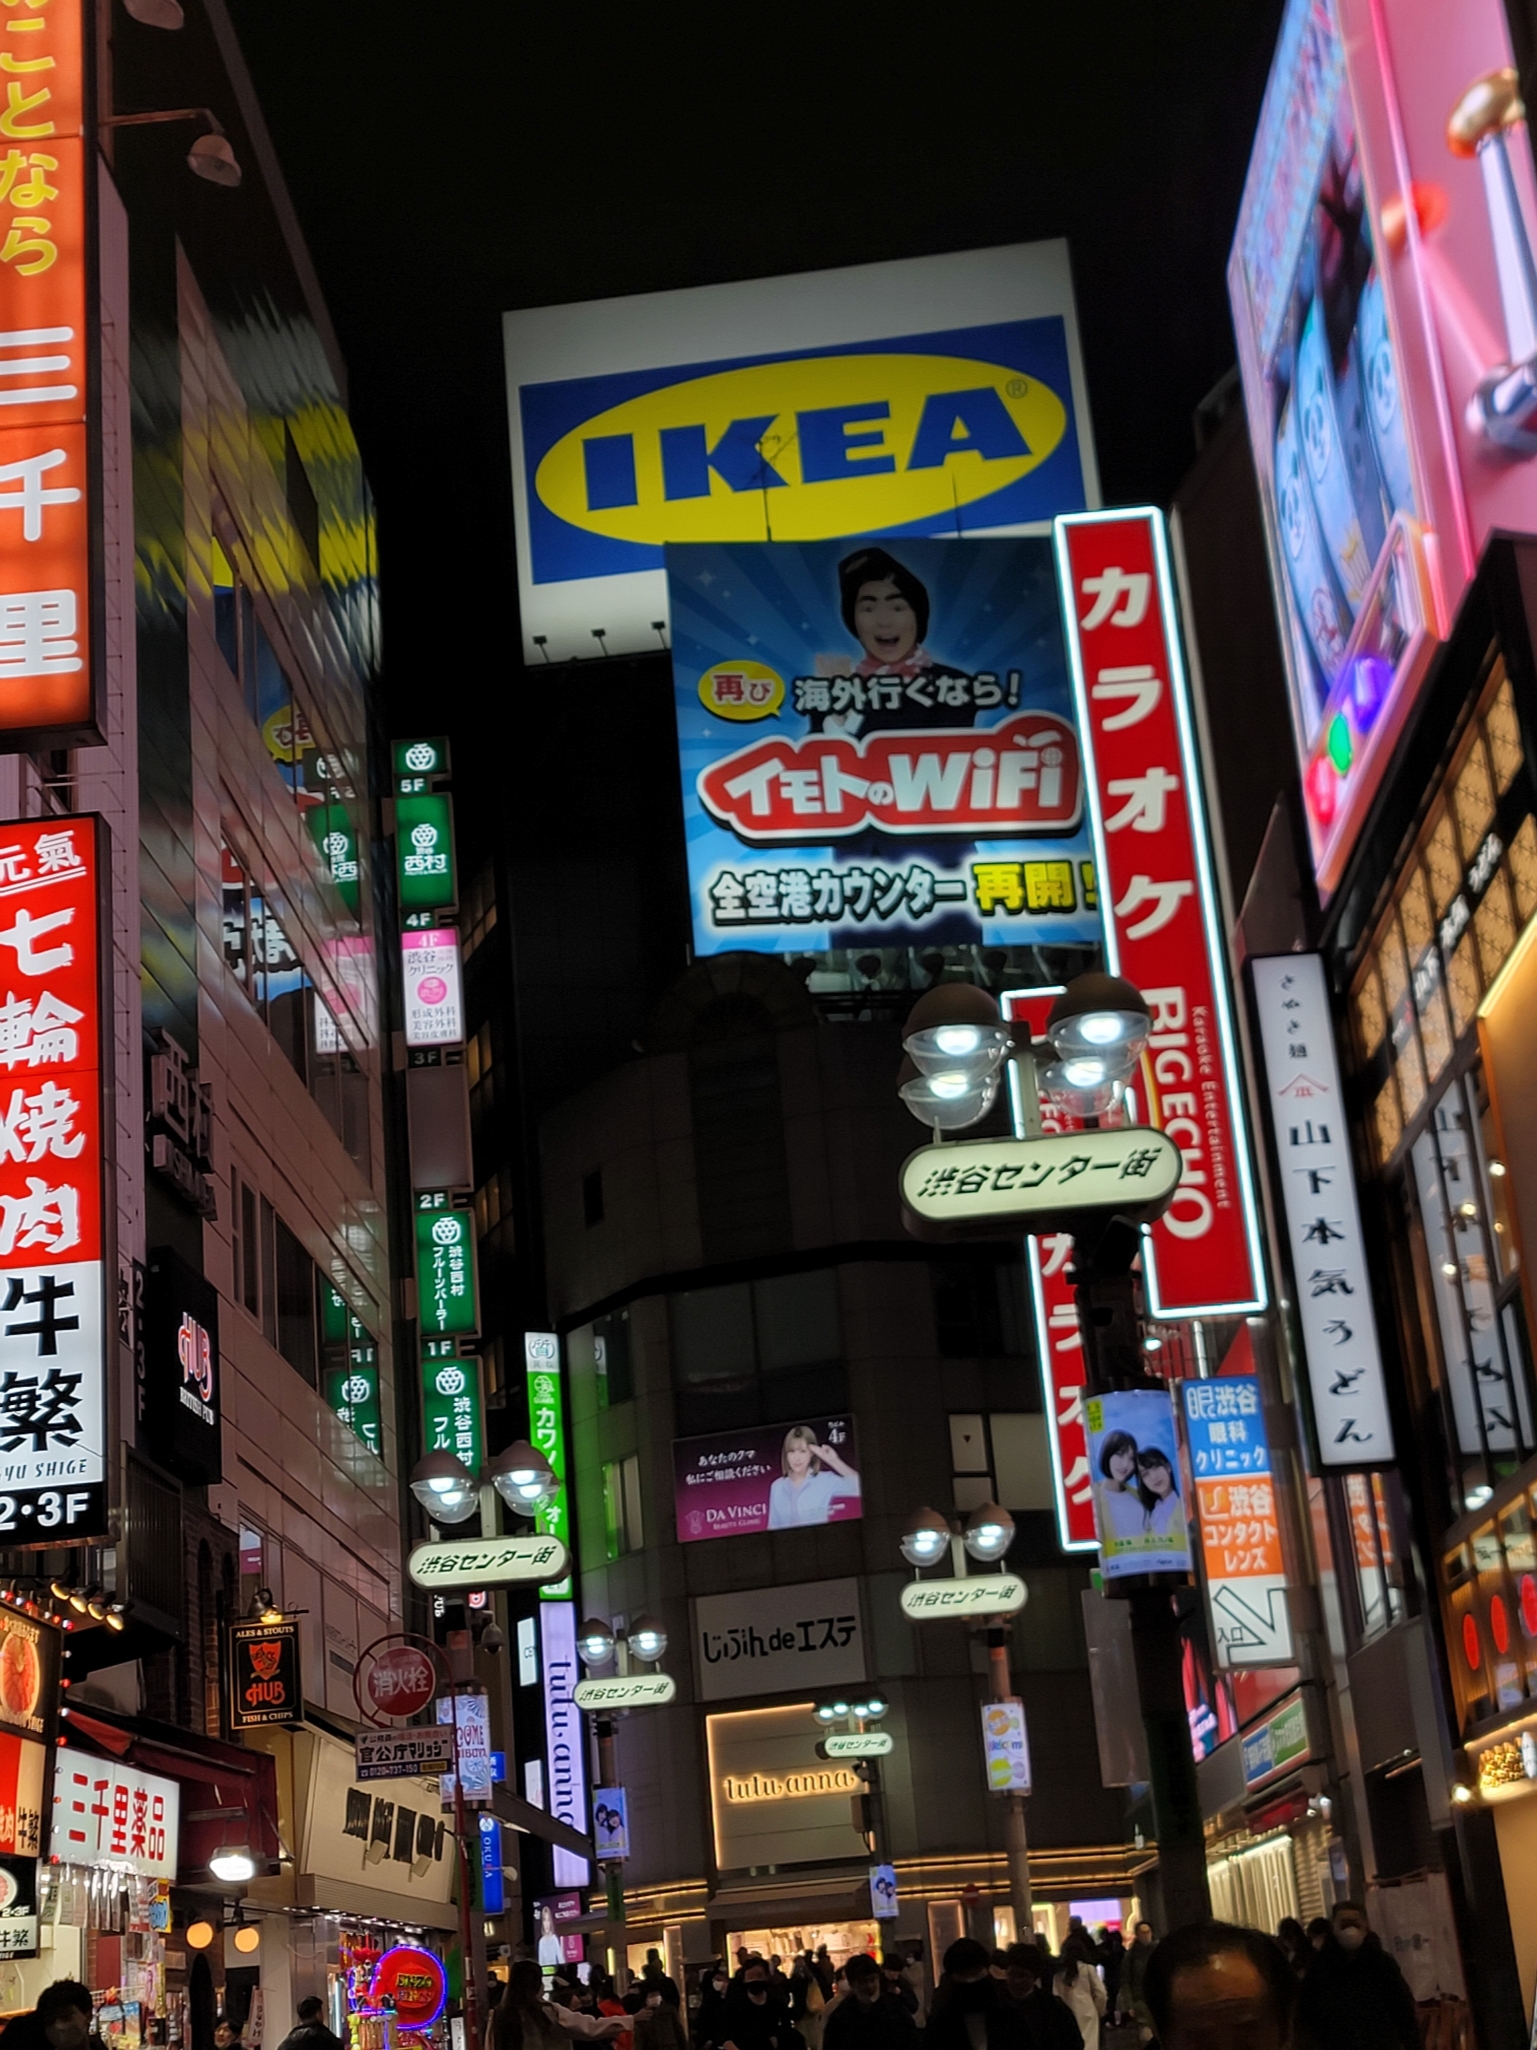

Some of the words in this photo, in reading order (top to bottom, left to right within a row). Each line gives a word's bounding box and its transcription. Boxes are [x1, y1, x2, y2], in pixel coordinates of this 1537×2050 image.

[0, 0, 59, 276] ことなら
[582, 385, 1034, 512] IKEA
[0, 326, 83, 678] 三千里
[713, 672, 772, 704] 再び
[794, 672, 1022, 714] 海外行くなら!
[1081, 566, 1194, 941] カラオケ
[401, 778, 424, 793] 5F
[723, 746, 1063, 816] イモトのWiFi
[404, 854, 447, 872] 西村
[406, 912, 432, 928] 4F
[418, 932, 440, 948] 4F
[407, 950, 437, 965] 渋谷
[408, 963, 454, 977] クリニック
[1191, 1005, 1215, 1075] Karaoke
[414, 1052, 437, 1065] 3F
[1201, 1081, 1232, 1210] Entertainment
[917, 1147, 1163, 1197] 渋谷センター街
[1160, 1092, 1214, 1240] ECHO
[419, 1193, 445, 1208] 2F
[448, 1245, 464, 1296] 渋谷西村
[1288, 1118, 1374, 1445] 山下本気うどん
[432, 1246, 449, 1331] フルーツパーラー
[427, 1341, 451, 1356] 1F
[0, 1275, 84, 1453] 牛繁
[1215, 1384, 1257, 1416] 渋谷
[202, 1403, 214, 1425] PUB
[453, 1397, 473, 1466] 渋谷西村
[828, 1429, 846, 1443] 4F
[1208, 1421, 1248, 1444] 眼科
[0, 1464, 27, 1481] YU
[36, 1458, 88, 1478] SHIGE
[698, 1450, 755, 1466] あなたのクマ
[1196, 1445, 1266, 1472] クリニック
[686, 1465, 771, 1485] 私にご相談ください
[706, 1510, 726, 1522] DA
[727, 1503, 767, 1518] VINCI
[1229, 1484, 1272, 1517] 渋谷
[1204, 1520, 1279, 1547] コンタクト
[416, 1546, 557, 1574] 渋谷センター街
[1224, 1549, 1268, 1572] レンズ
[906, 1585, 1017, 1608] 渋谷センター街
[236, 1629, 256, 1638] ALES
[264, 1626, 294, 1635] STOUTS
[1217, 1625, 1244, 1644] 入口
[245, 1681, 286, 1707] HUB
[373, 1665, 430, 1698] 消火栓
[578, 1682, 669, 1701] 渋谷センター街
[242, 1714, 259, 1723] FISH
[268, 1711, 293, 1720] CHIPS
[369, 1764, 418, 1776] 0120-737-150
[723, 1776, 783, 1802] tutu
[786, 1770, 855, 1795] anna
[69, 1772, 166, 1862] 三千里薬品
